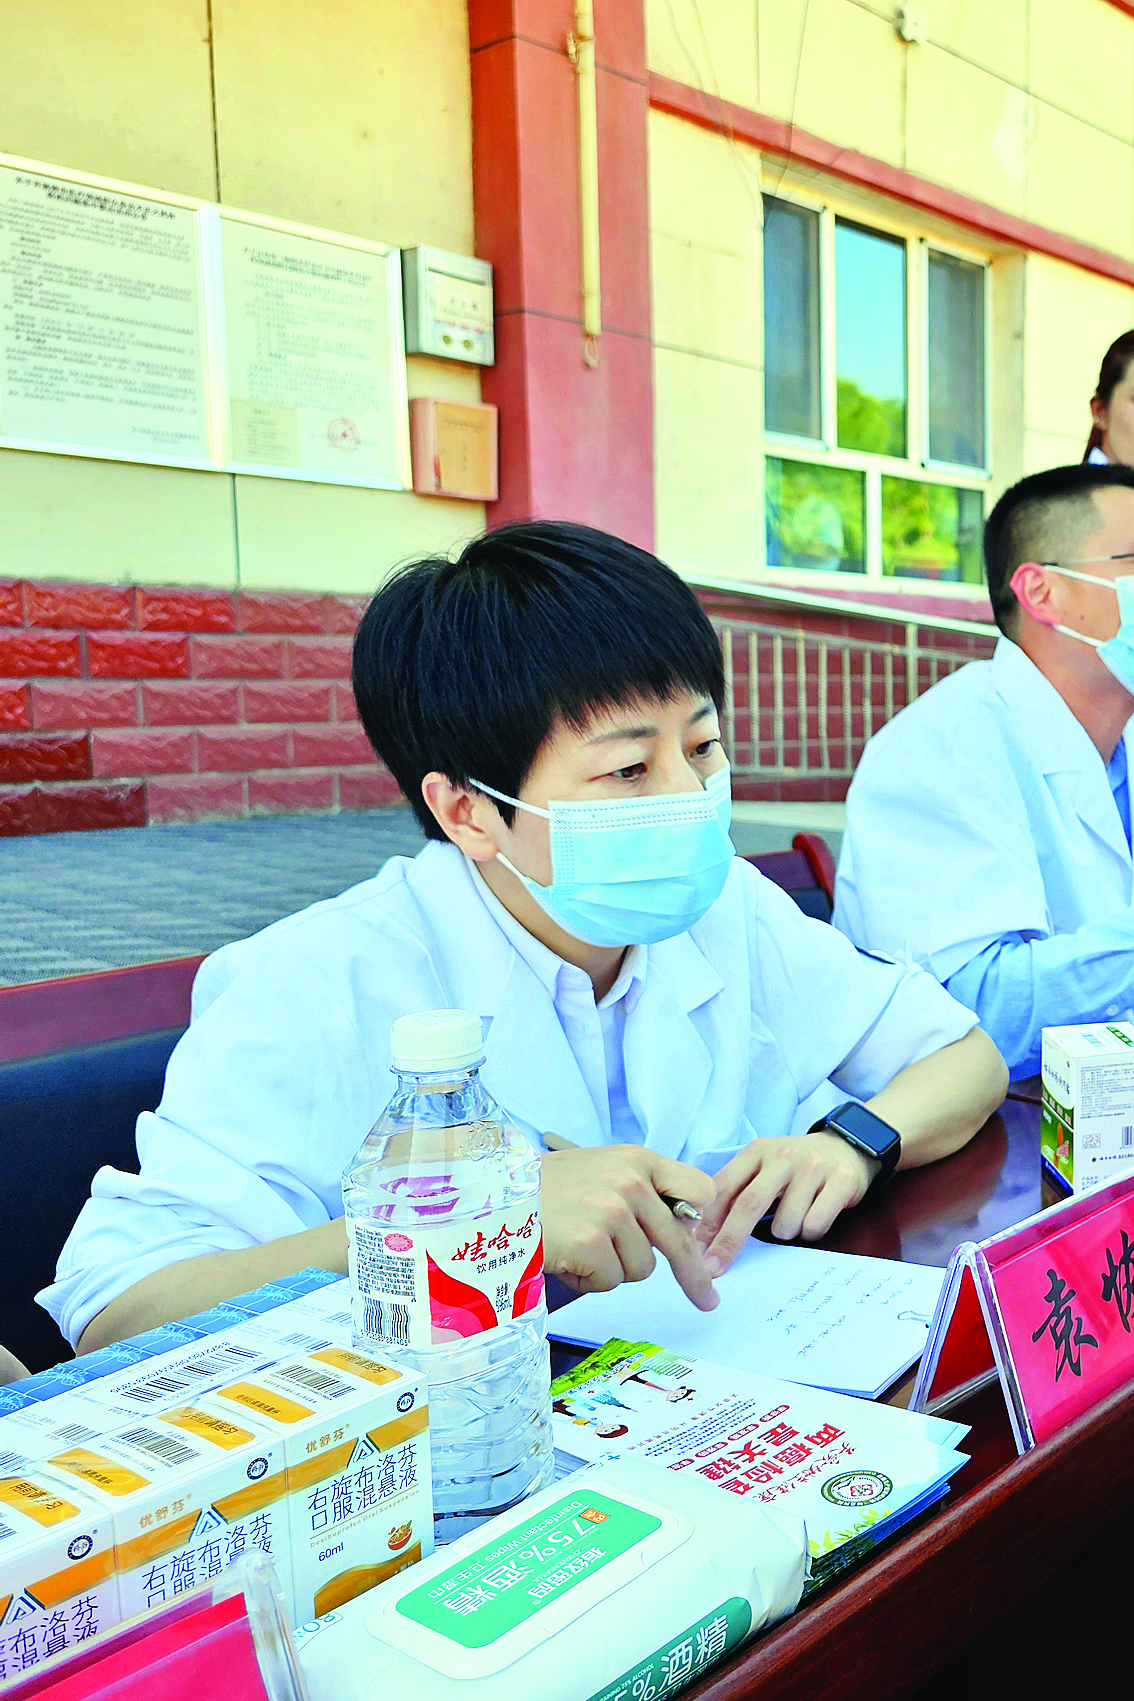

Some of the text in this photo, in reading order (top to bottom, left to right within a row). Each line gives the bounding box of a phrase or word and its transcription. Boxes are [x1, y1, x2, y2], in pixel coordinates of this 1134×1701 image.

[451, 1213, 534, 1262] 娃哈哈
[477, 1247, 526, 1274] 饮用纯净水
[306, 1427, 344, 1453] 优舒芬
[695, 1422, 800, 1480] 是关键
[718, 1423, 847, 1495] 两癌检查
[308, 1443, 417, 1511] 右旋布洛芬
[311, 1464, 418, 1531] 口服混悬液
[139, 1499, 185, 1528] 优舒芬
[362, 1510, 379, 1522] Oral
[379, 1490, 420, 1516] Suspension
[485, 1501, 583, 1562] Disinfectant Wipes
[142, 1513, 273, 1591] 右旋布洛芬
[318, 1542, 344, 1562] 60ml
[528, 1546, 607, 1599] 指纹密码
[428, 1560, 488, 1598] 卫生湿巾
